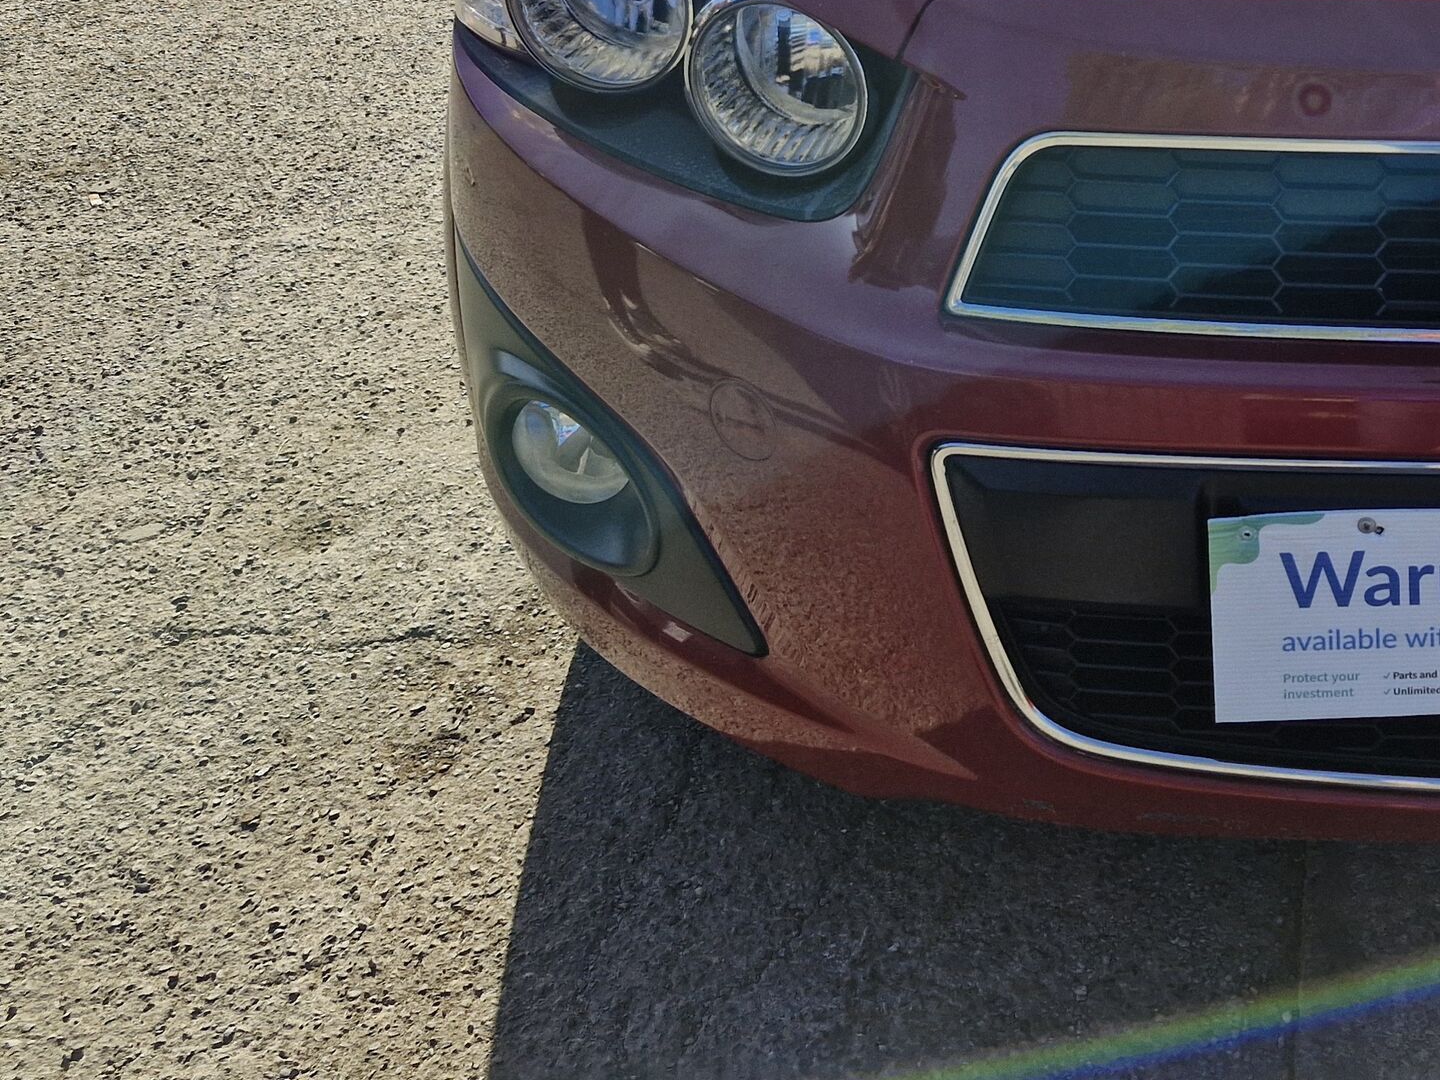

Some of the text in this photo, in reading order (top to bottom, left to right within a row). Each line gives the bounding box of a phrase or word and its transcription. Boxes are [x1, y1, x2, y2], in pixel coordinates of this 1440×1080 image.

[1282, 628, 1398, 652] available
[1283, 672, 1361, 684] Protect your
[1393, 671, 1418, 680] Parts
[1419, 670, 1438, 679] and
[1283, 688, 1354, 699] investment
